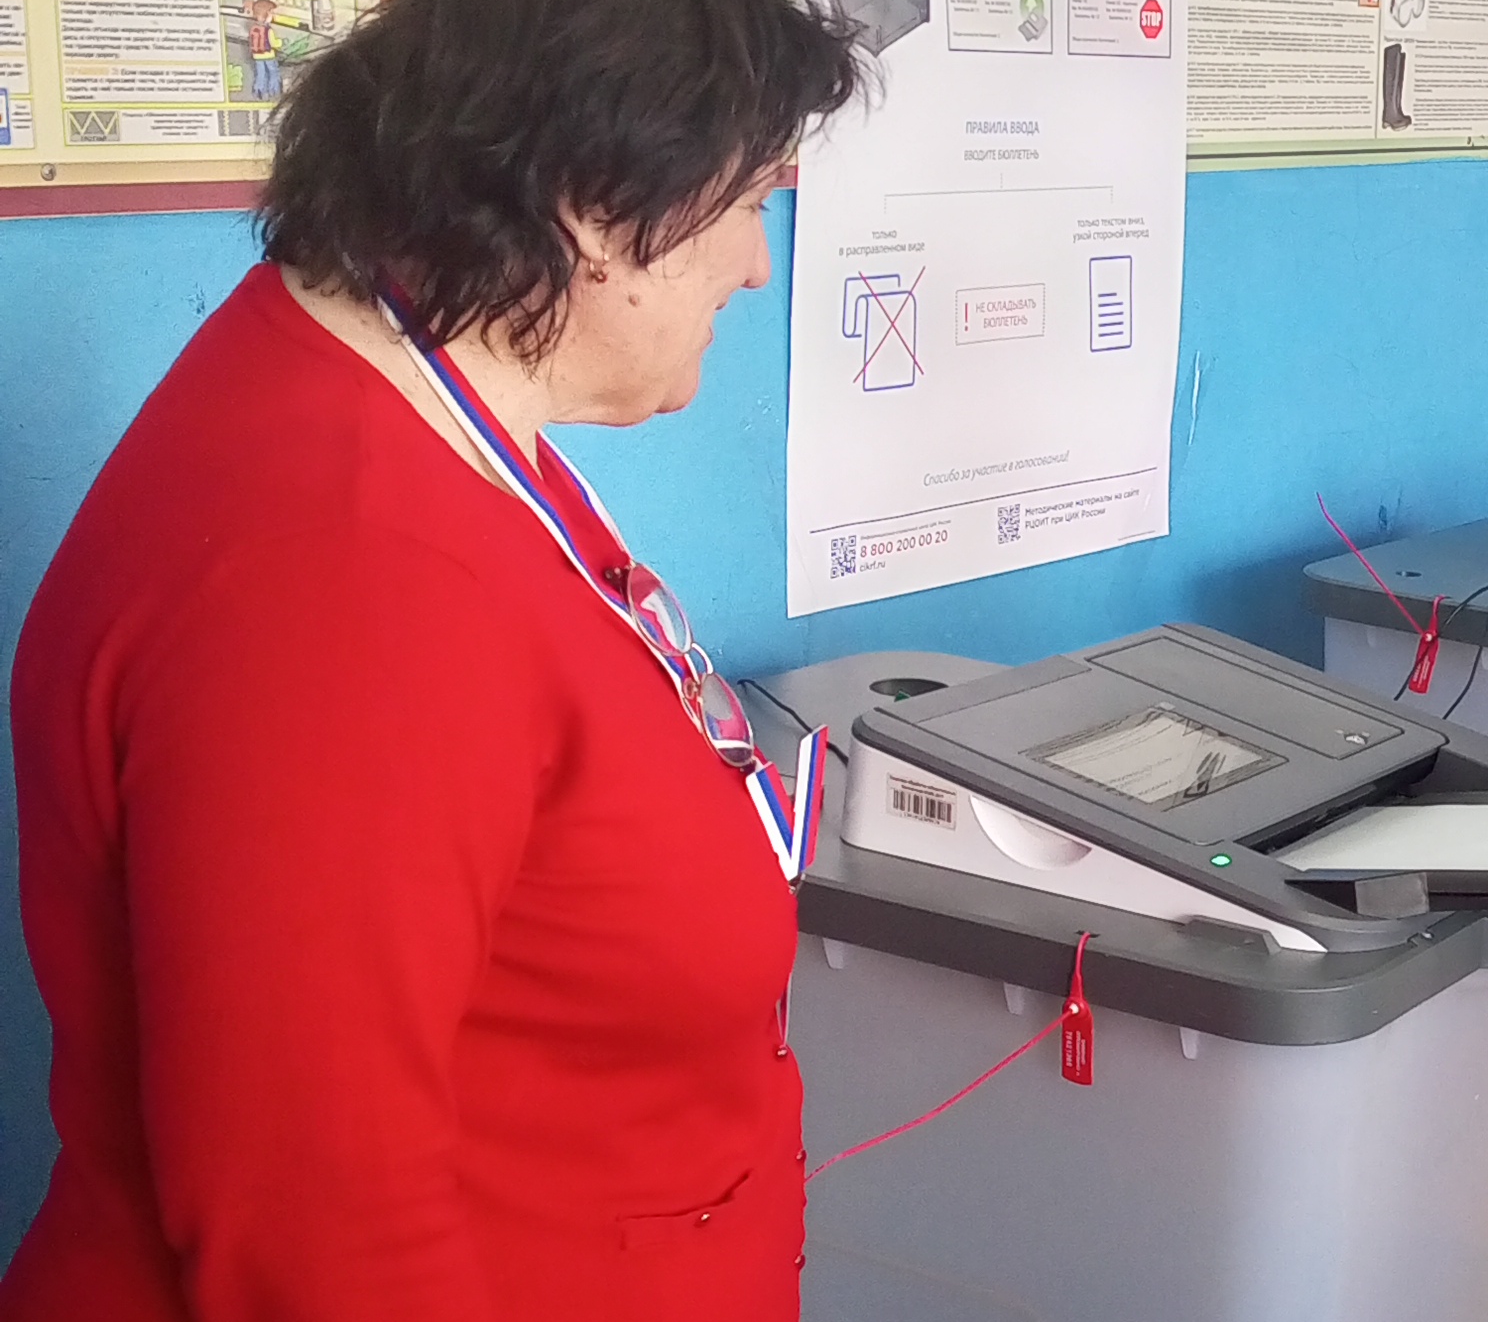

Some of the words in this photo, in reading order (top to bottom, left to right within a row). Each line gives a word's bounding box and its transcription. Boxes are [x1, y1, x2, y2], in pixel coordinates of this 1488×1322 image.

[1141, 11, 1162, 27] STOP
[965, 121, 1008, 133] ПРАВИЛА
[1010, 121, 1039, 135] ВВОДА
[964, 149, 996, 161] ВВОДИТЕ
[997, 149, 1038, 159] БЮЛЛЕТЕНЬ
[976, 301, 985, 313] НЕ
[986, 298, 1036, 312] СКЛАДЫВАТЬ
[983, 315, 1028, 328] БЮЛЛЕТЕНЬ
[924, 468, 958, 486] Спасибо
[970, 463, 1006, 480] участие
[860, 545, 866, 557] 8
[870, 540, 893, 556] 800
[896, 536, 916, 551] 200
[918, 533, 932, 547] 00
[934, 529, 947, 543] 20
[860, 560, 885, 572] cikrf.ru
